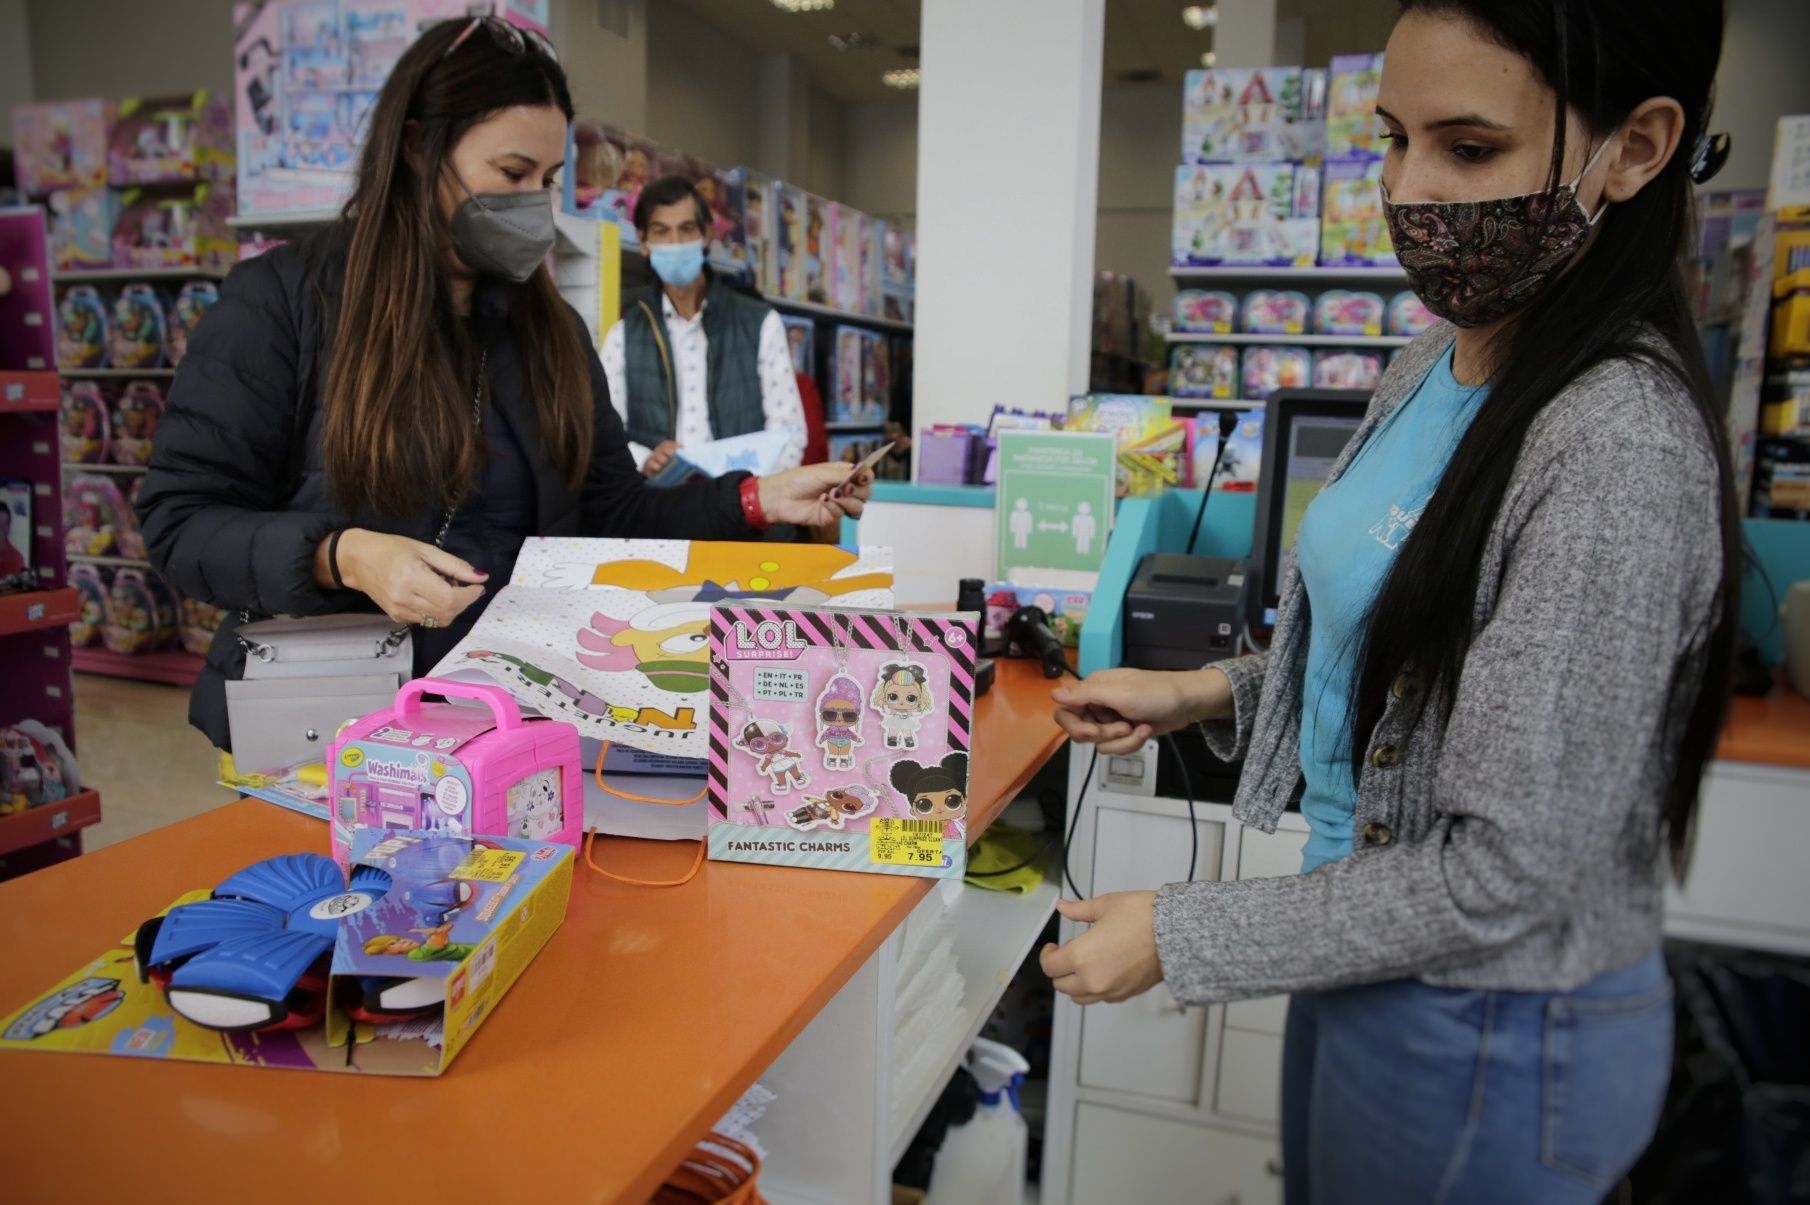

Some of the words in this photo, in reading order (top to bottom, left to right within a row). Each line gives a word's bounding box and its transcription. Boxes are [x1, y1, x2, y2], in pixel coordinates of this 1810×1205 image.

[947, 631, 964, 643] 6+
[736, 650, 794, 659] SURPRISE!
[727, 841, 796, 852] FANTASTIC
[799, 842, 851, 852] CHARMS
[907, 852, 933, 862] 7.95
